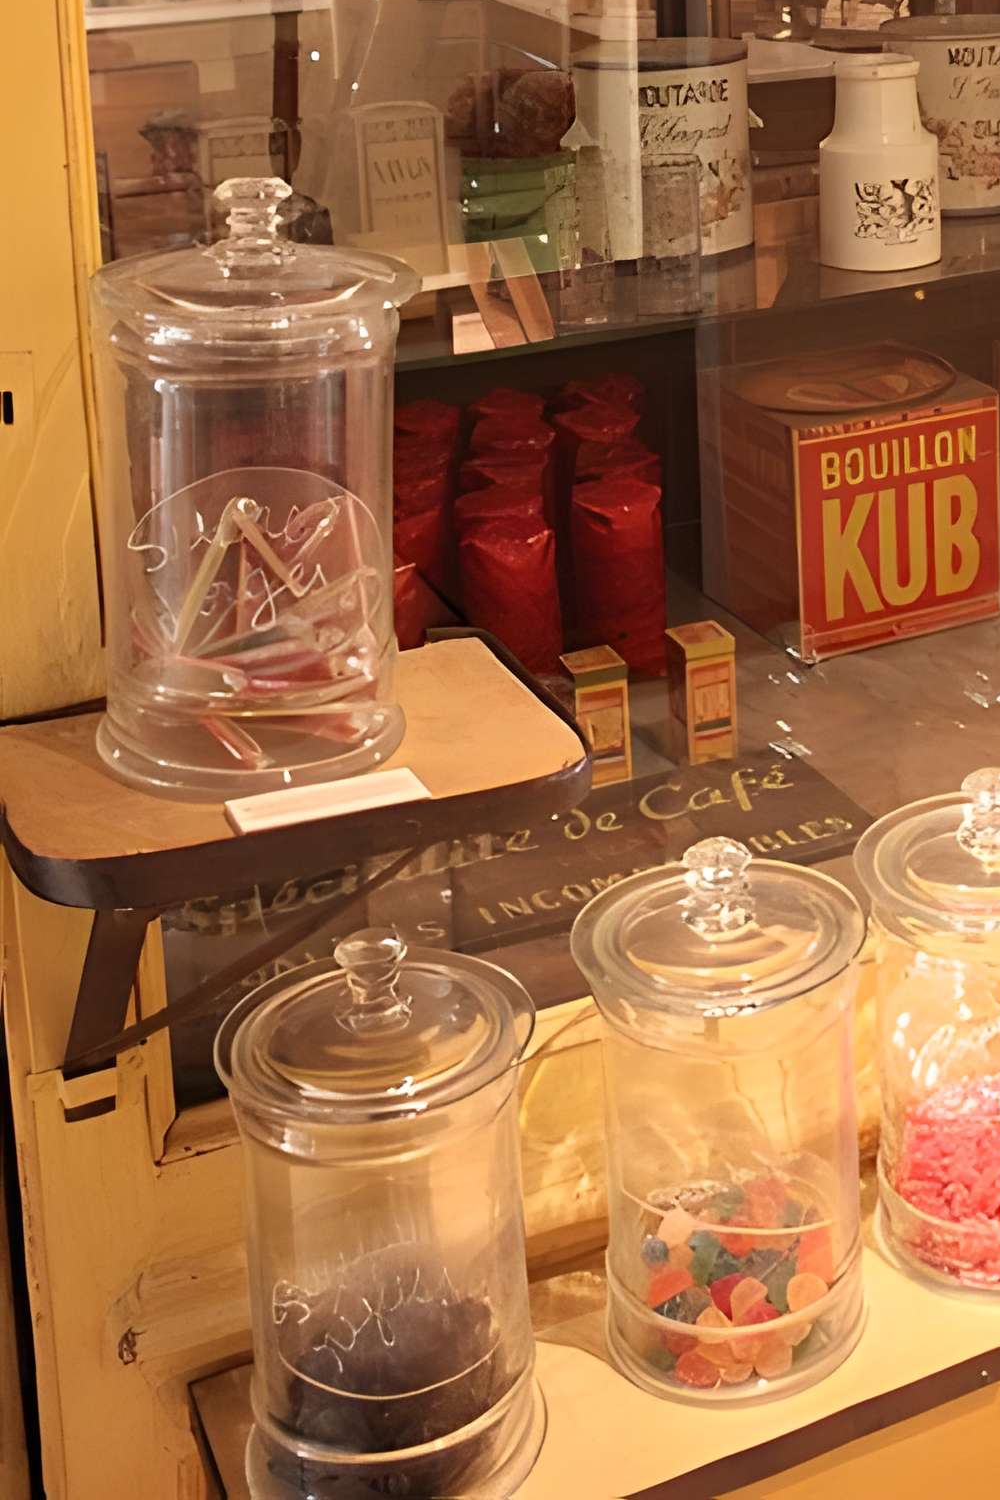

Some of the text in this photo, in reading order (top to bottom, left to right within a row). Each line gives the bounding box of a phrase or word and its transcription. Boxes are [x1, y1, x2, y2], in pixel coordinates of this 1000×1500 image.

[820, 425, 977, 491] BOUILLON
[821, 473, 982, 622] KUB
[564, 808, 624, 840] de
[638, 764, 795, 821] Café
